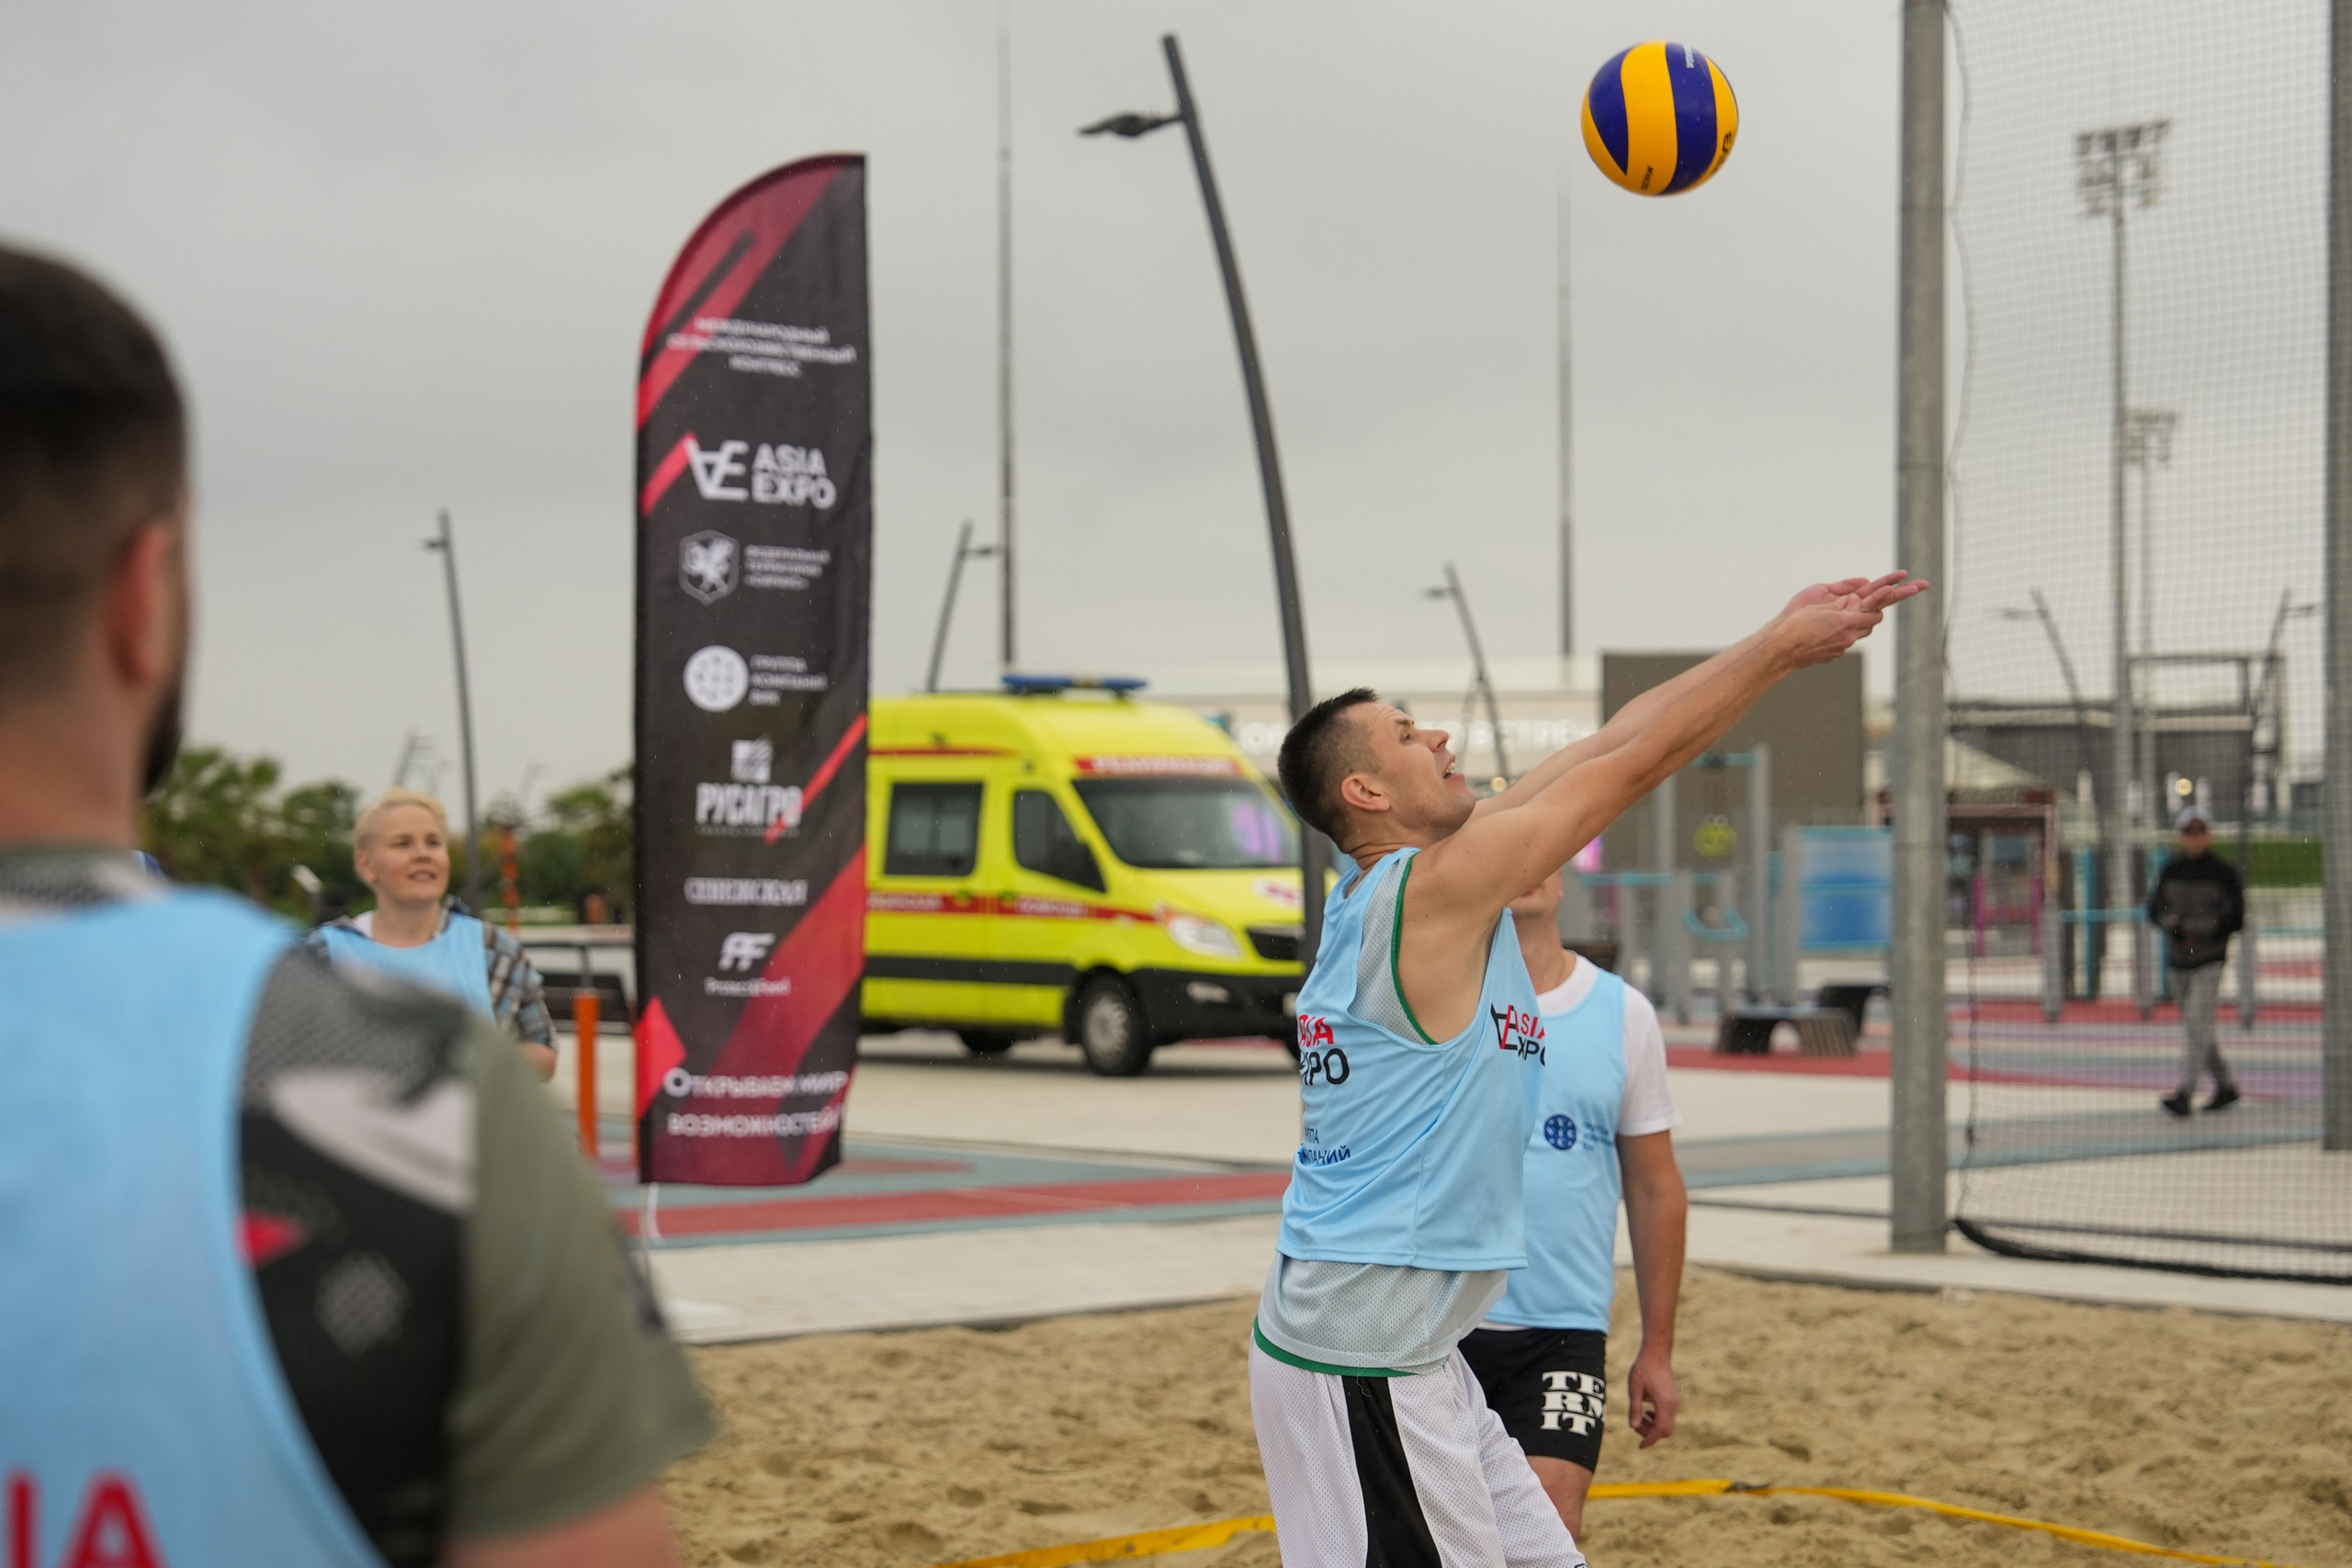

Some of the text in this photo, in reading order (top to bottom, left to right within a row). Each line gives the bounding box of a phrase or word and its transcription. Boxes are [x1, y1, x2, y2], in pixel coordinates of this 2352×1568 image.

[754, 444, 826, 476] ASIA
[753, 473, 835, 507] EXPO
[696, 783, 803, 827] РУСАГРО
[1539, 1410, 1596, 1437] IT
